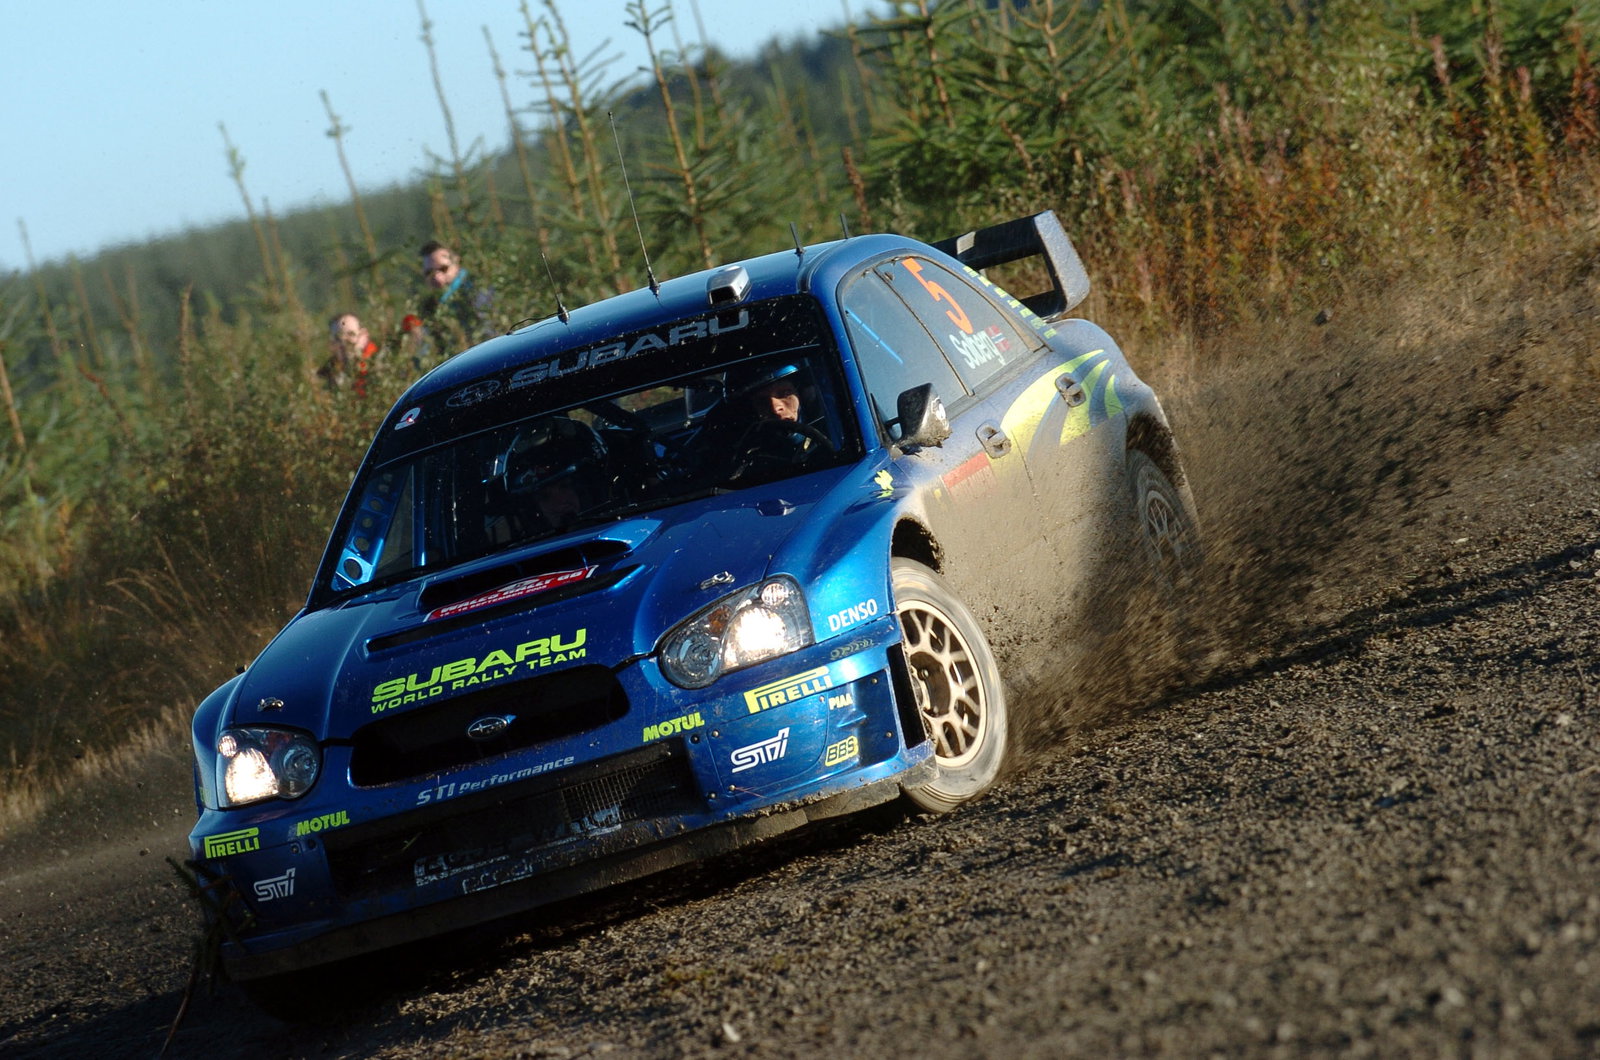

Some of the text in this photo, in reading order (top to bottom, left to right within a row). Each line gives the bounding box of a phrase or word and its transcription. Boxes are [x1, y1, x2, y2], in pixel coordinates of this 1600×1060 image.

[901, 257, 973, 335] 5
[508, 310, 749, 390] SUBARU
[948, 330, 1006, 369] Solberg
[827, 598, 878, 632] DENSO
[371, 628, 587, 702] SUBARU
[371, 648, 586, 714] WORLD RALLY TEAM
[743, 666, 833, 714] PIRELLI
[643, 712, 705, 742] MOTUL
[825, 736, 859, 765] BBS
[416, 782, 455, 805] STI
[296, 810, 350, 836] MOTUL
[204, 827, 260, 859] PIRELLI
